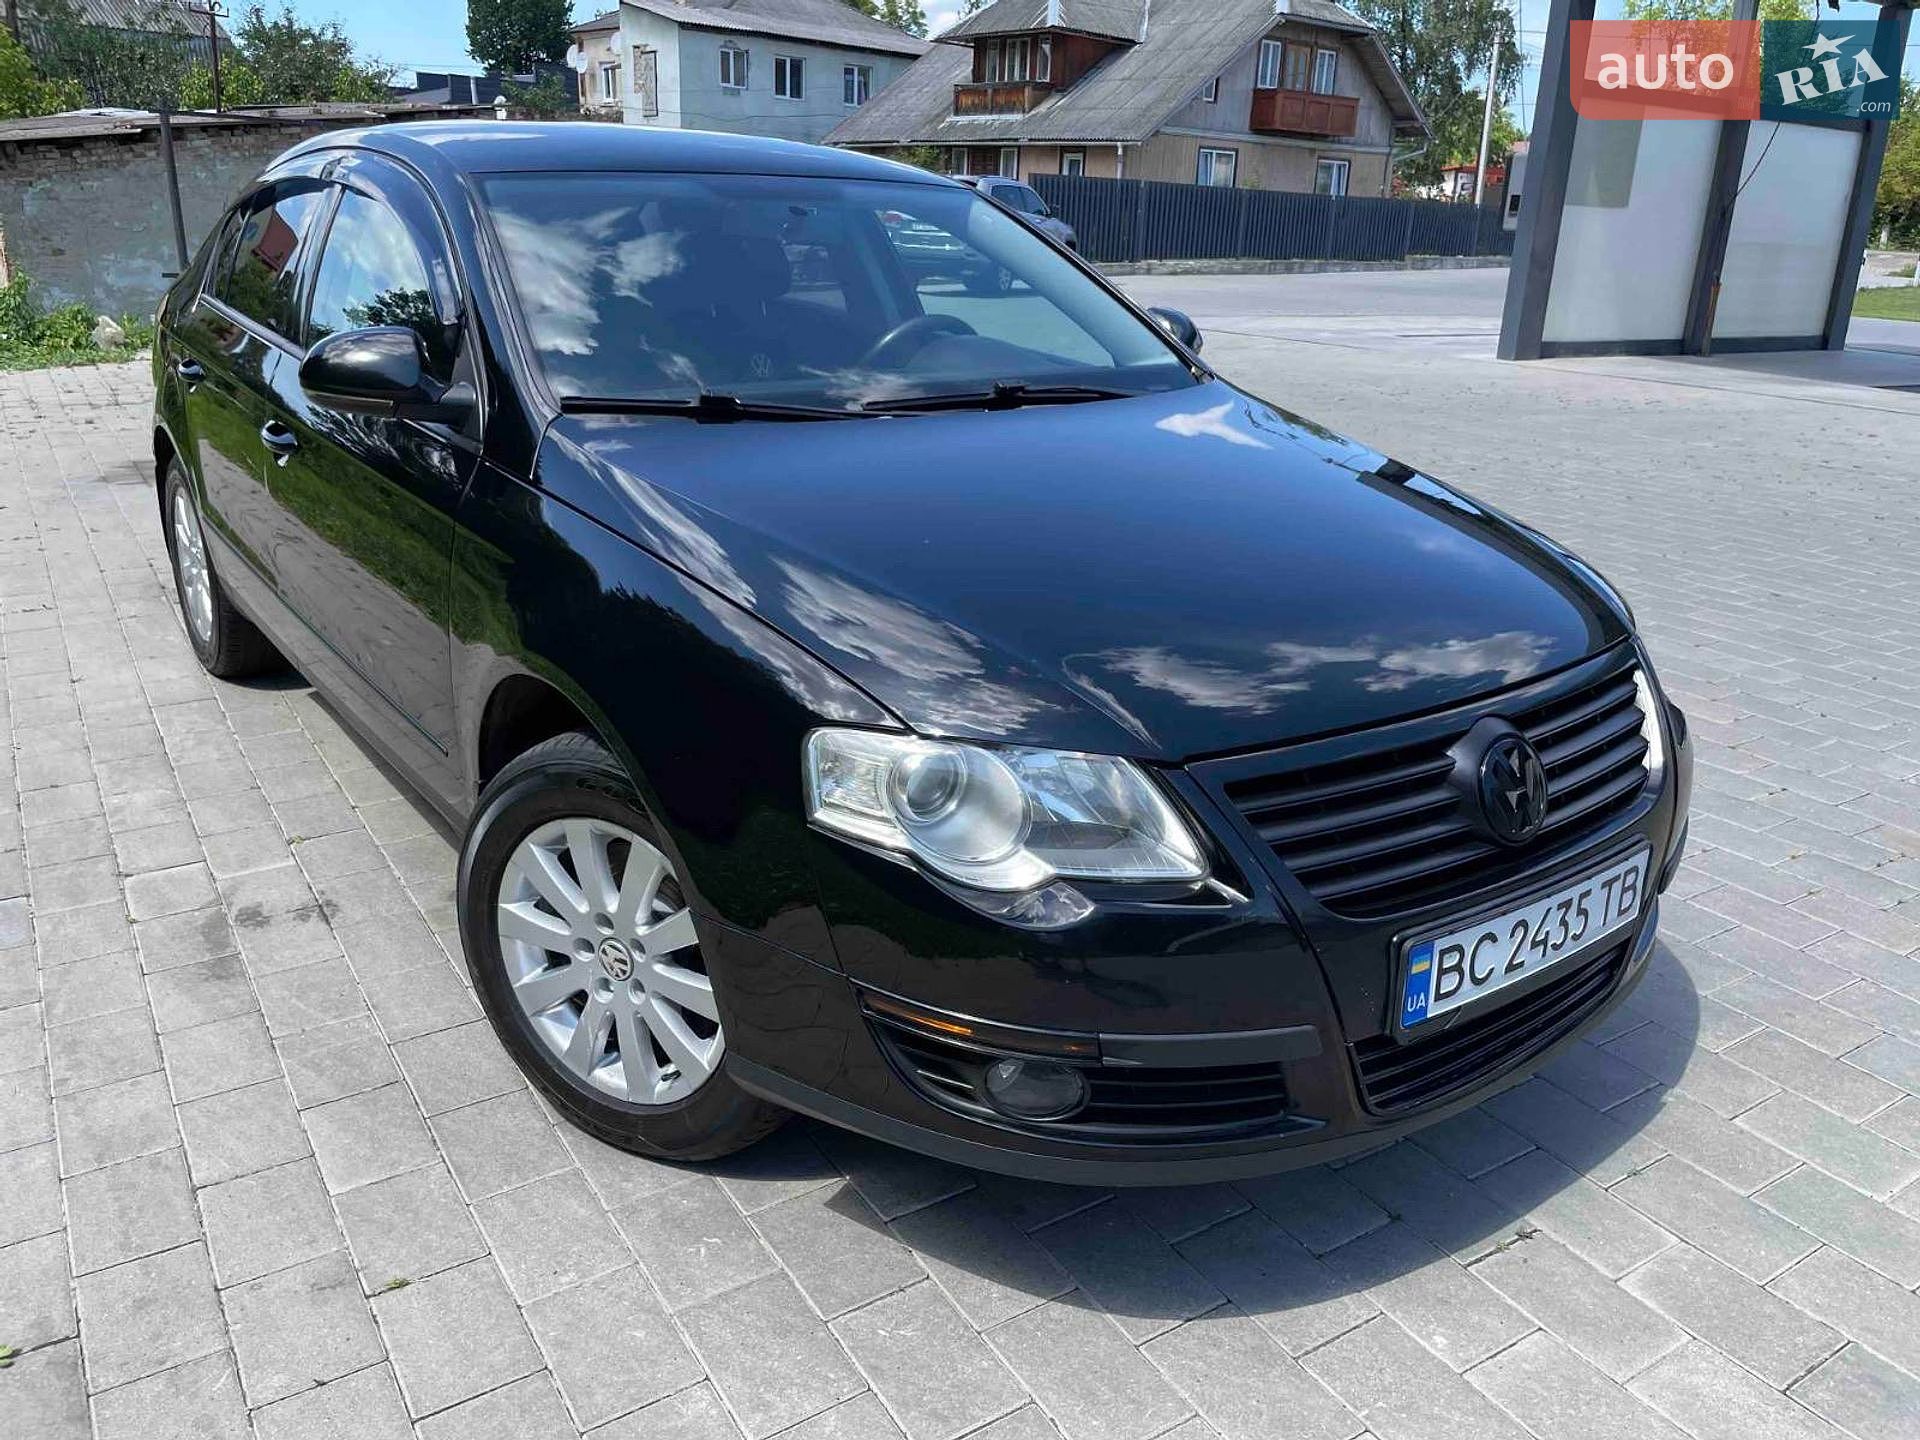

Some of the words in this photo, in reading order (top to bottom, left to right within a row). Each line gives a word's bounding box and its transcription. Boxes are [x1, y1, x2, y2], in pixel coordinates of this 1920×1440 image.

[1433, 931, 1498, 1003] BC
[1504, 889, 1592, 976] 2435
[1600, 865, 1640, 928] TB
[1406, 991, 1426, 1012] UA
